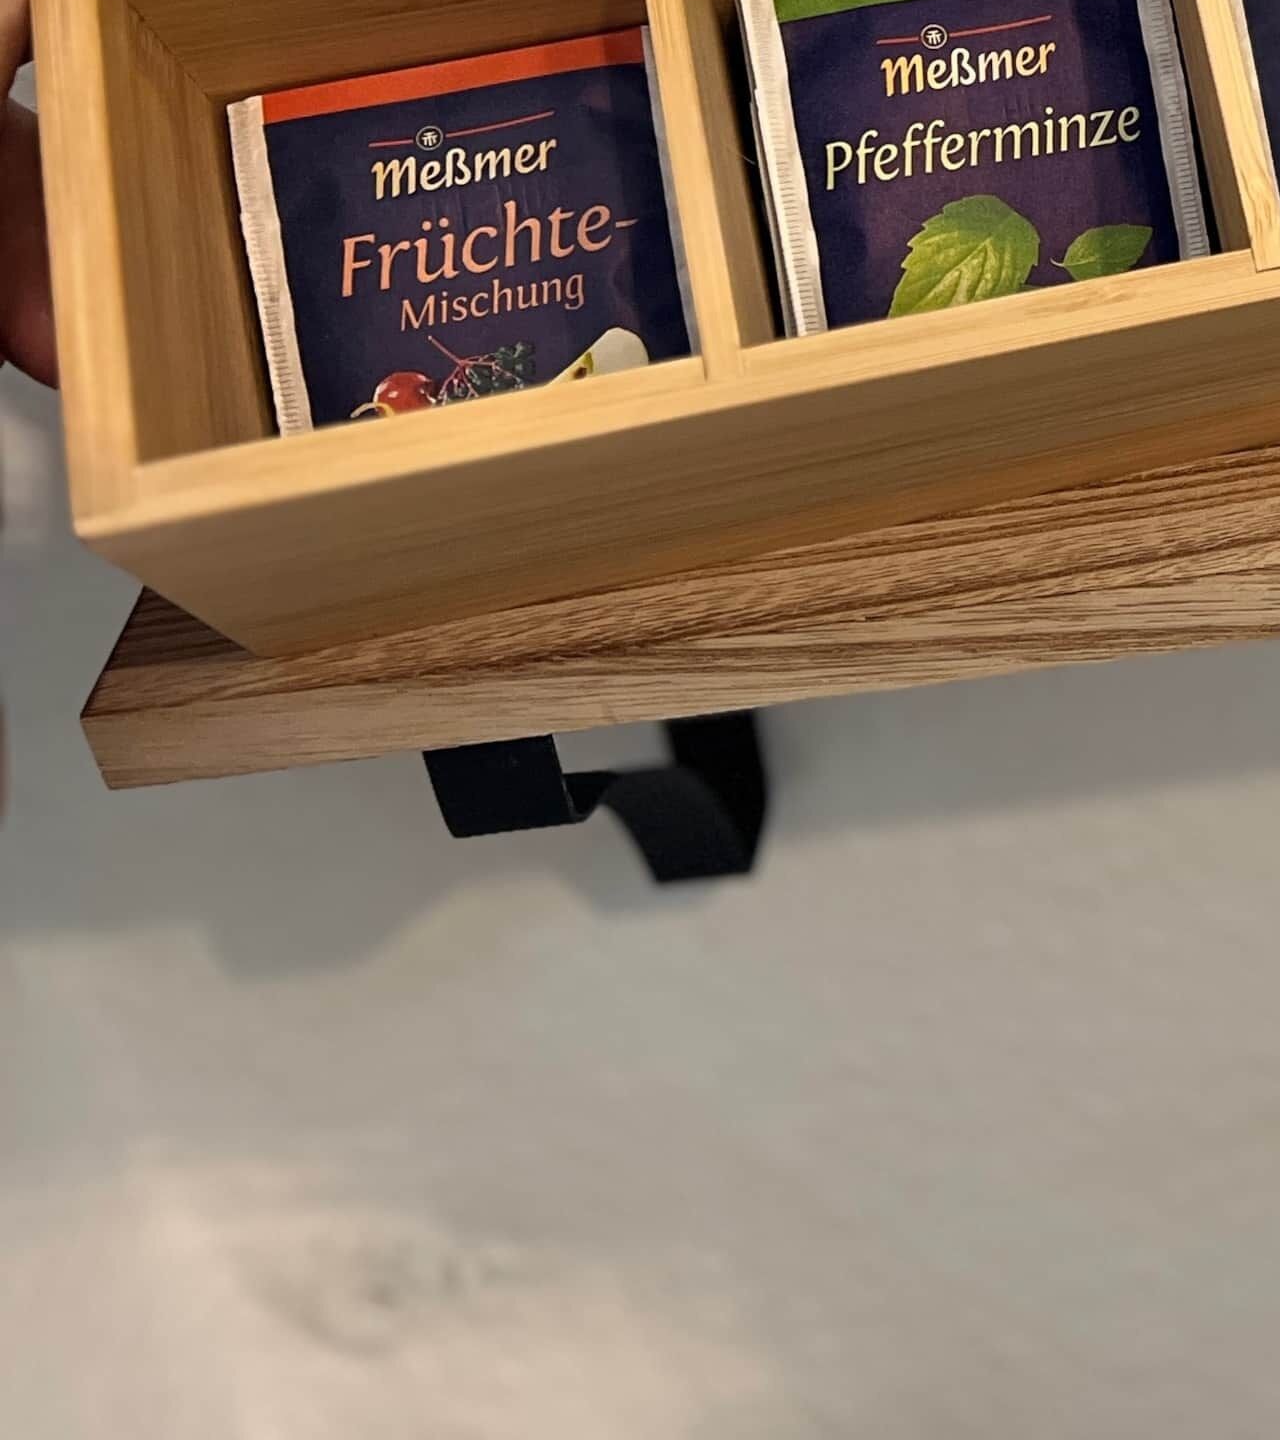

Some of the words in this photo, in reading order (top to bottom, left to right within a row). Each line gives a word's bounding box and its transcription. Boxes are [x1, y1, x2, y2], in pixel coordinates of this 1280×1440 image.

[879, 40, 1056, 97] Meßmer
[370, 137, 557, 201] Meßmer
[824, 105, 1141, 191] Pfefferminze
[340, 199, 639, 298] Früchte-
[400, 273, 585, 332] Mischung
